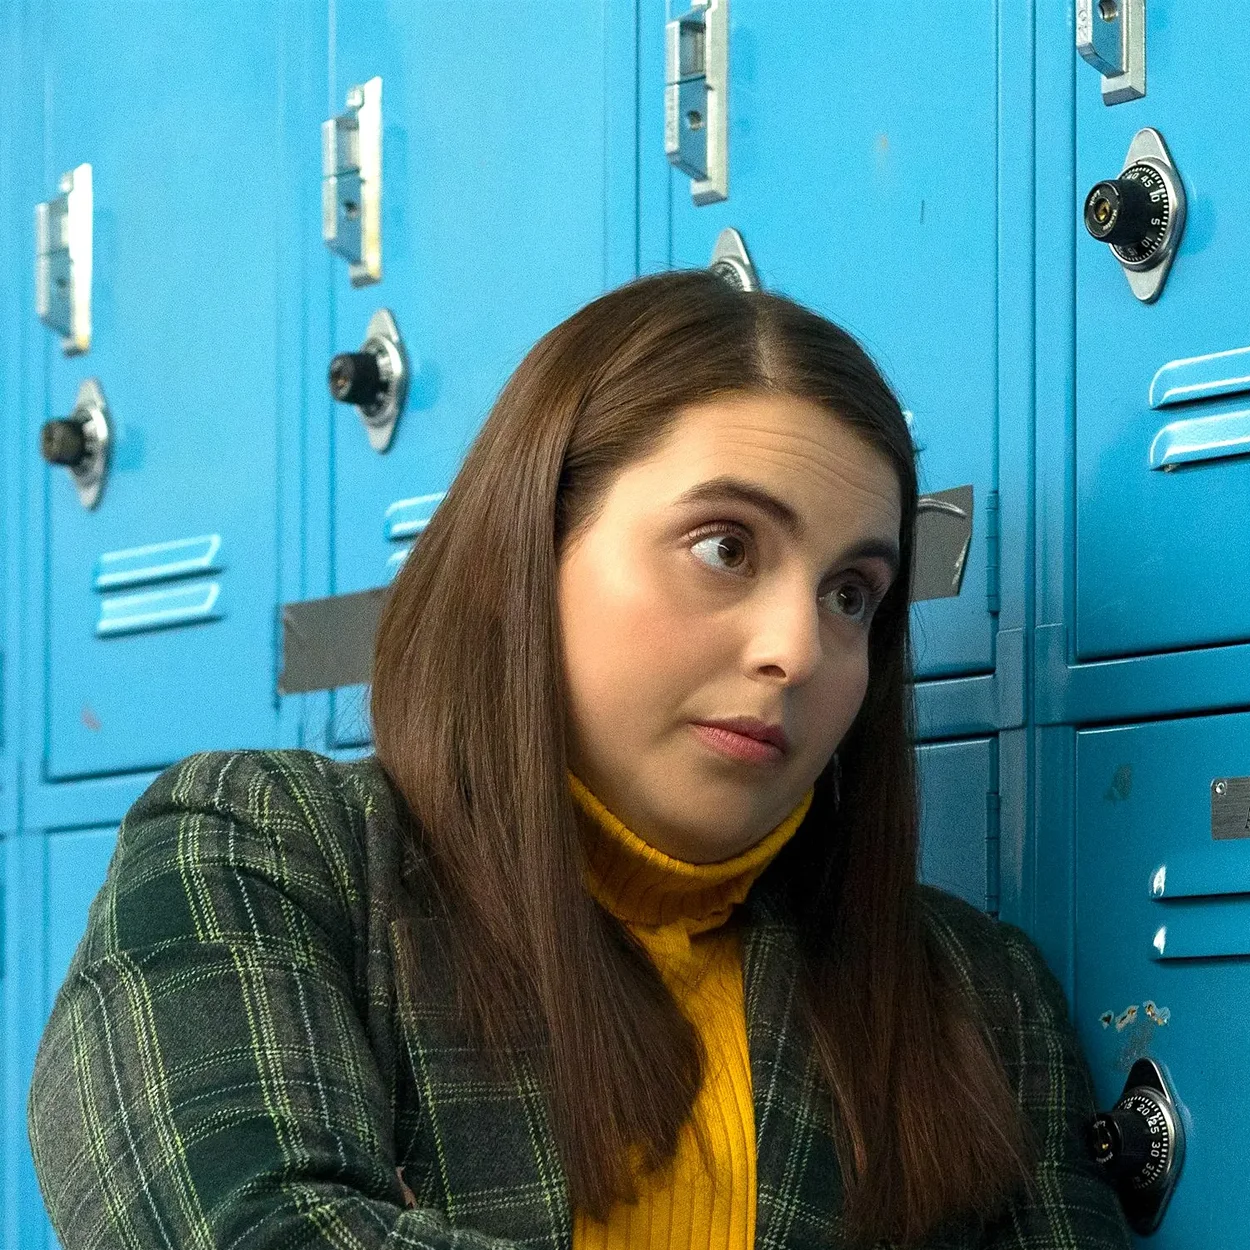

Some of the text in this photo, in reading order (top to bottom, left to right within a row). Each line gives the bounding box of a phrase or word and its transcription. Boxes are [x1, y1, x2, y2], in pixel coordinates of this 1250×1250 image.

[1140, 175, 1154, 188] 45
[1151, 217, 1161, 226] 5
[1141, 236, 1153, 248] 10
[1136, 1103, 1150, 1116] 20
[1147, 1116, 1160, 1135] 25
[1151, 1141, 1161, 1158] 30
[1142, 1162, 1155, 1177] 35
